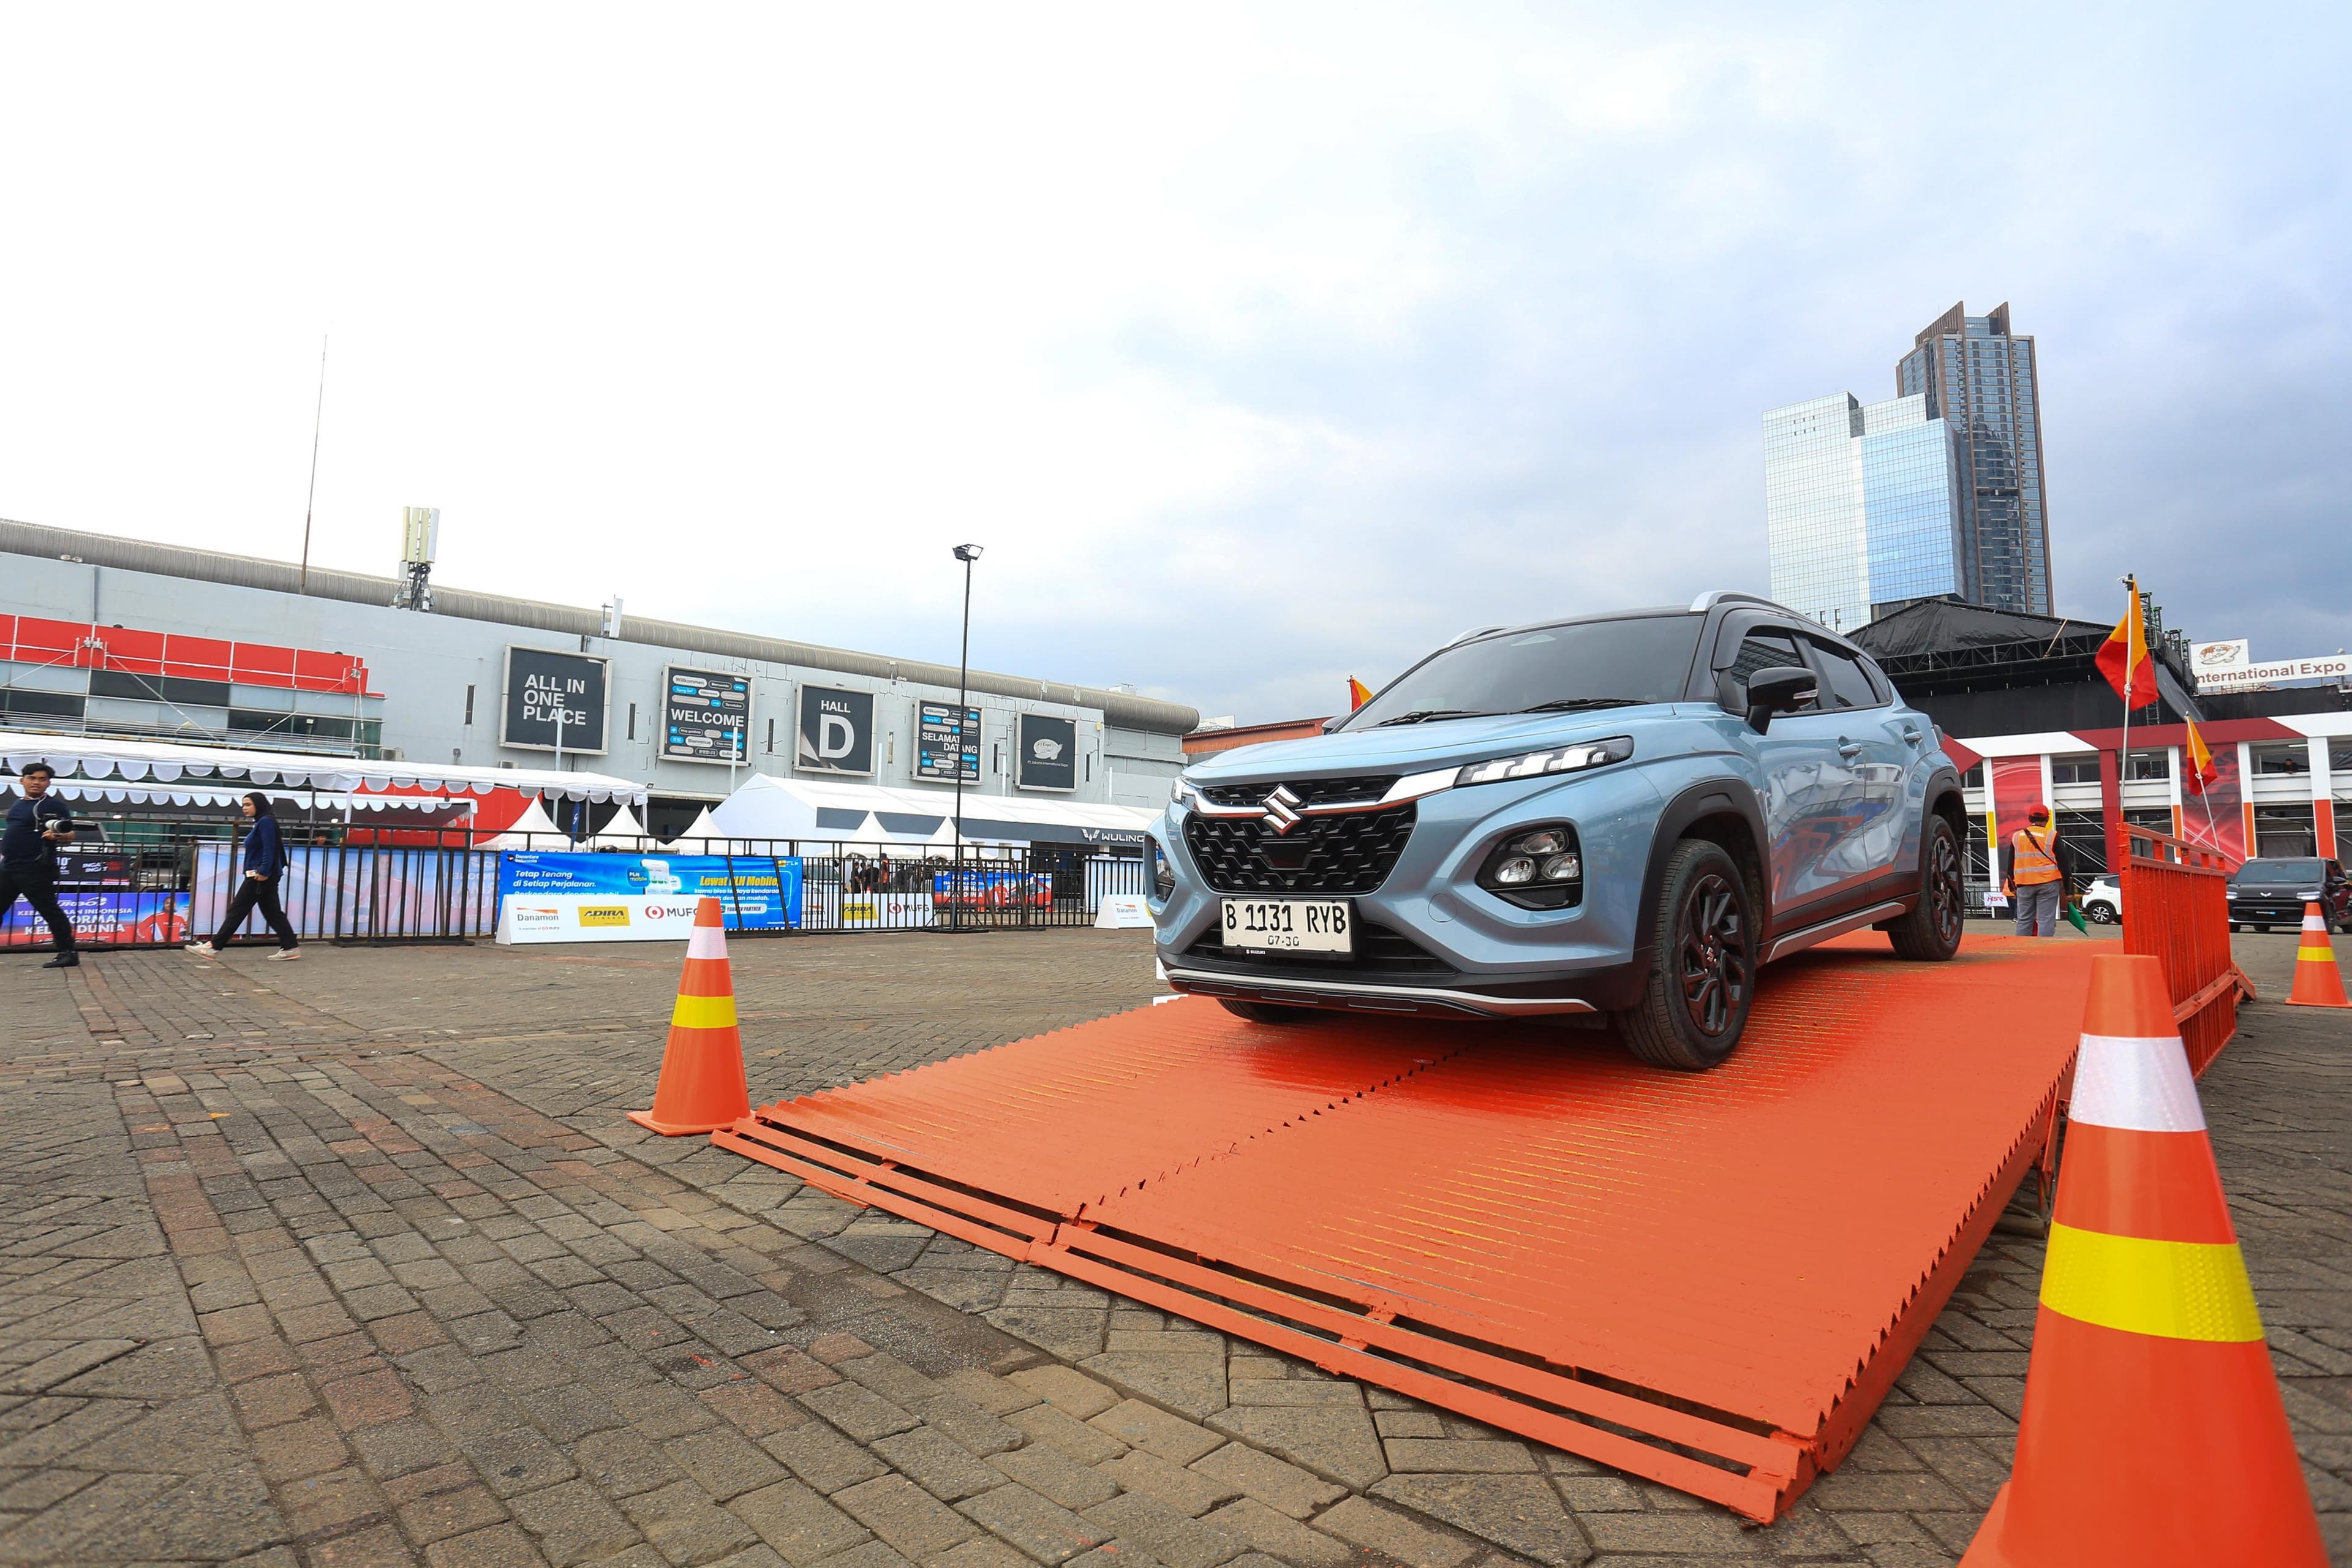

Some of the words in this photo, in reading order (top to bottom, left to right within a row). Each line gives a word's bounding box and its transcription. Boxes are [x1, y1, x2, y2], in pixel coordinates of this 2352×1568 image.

[2195, 665, 2294, 684] nternational
[2301, 662, 2346, 676] Expo
[524, 674, 562, 692] ALL
[567, 679, 585, 694] IN
[524, 690, 565, 707] ONE
[821, 699, 851, 713] HALL
[523, 706, 586, 725] PLACE
[671, 708, 745, 727] WELCOME
[819, 714, 854, 758] D
[922, 732, 960, 744] SELAMAT
[1102, 833, 1144, 842] WULING
[522, 880, 549, 889] Setiap
[551, 880, 597, 889] Perjalanan.
[699, 876, 728, 886] Lewat
[1226, 904, 1237, 929] B
[1245, 905, 1293, 932] 1131
[1306, 906, 1346, 934] RYB
[77, 924, 126, 933] DUNIA
